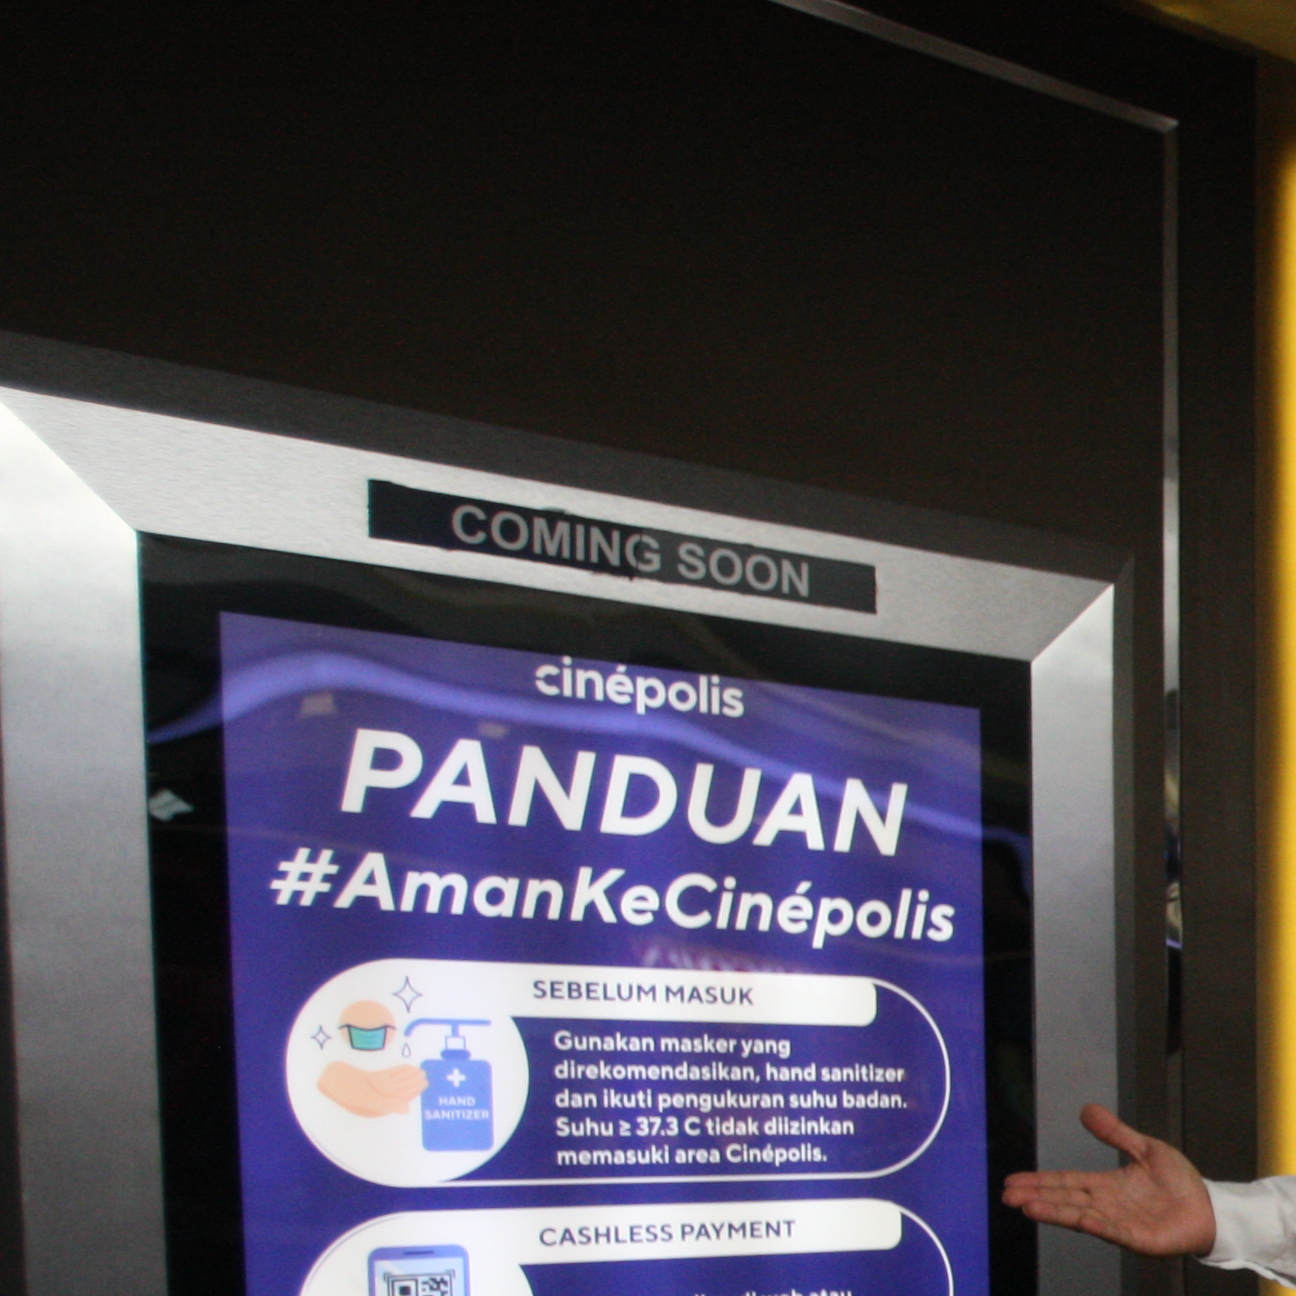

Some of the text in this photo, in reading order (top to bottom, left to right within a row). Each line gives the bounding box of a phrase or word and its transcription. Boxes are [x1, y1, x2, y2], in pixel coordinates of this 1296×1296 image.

[451, 505, 810, 598] COMING SOON
[535, 657, 744, 718] cinépolis
[341, 727, 907, 857] PANDUAN
[269, 846, 955, 948] #AmanKeCinépolis
[533, 980, 754, 1006] SEBELUM MASUK
[554, 1030, 790, 1058] Gunakan masker yang
[555, 1061, 905, 1083] direkomendasikan, hand sanitizer
[439, 1097, 475, 1106] HAND
[555, 1089, 907, 1112] dan ikuti pengukuran suhu badan.
[425, 1109, 489, 1120] SANITIZER
[556, 1117, 613, 1137] Suhu
[636, 1117, 679, 1136] 37.3
[706, 1117, 758, 1135] tidak
[764, 1117, 854, 1135] diizinkan
[557, 1143, 827, 1166] memasuki area Cinépolis.
[540, 1220, 795, 1246] CASHLESS PAYMENT
